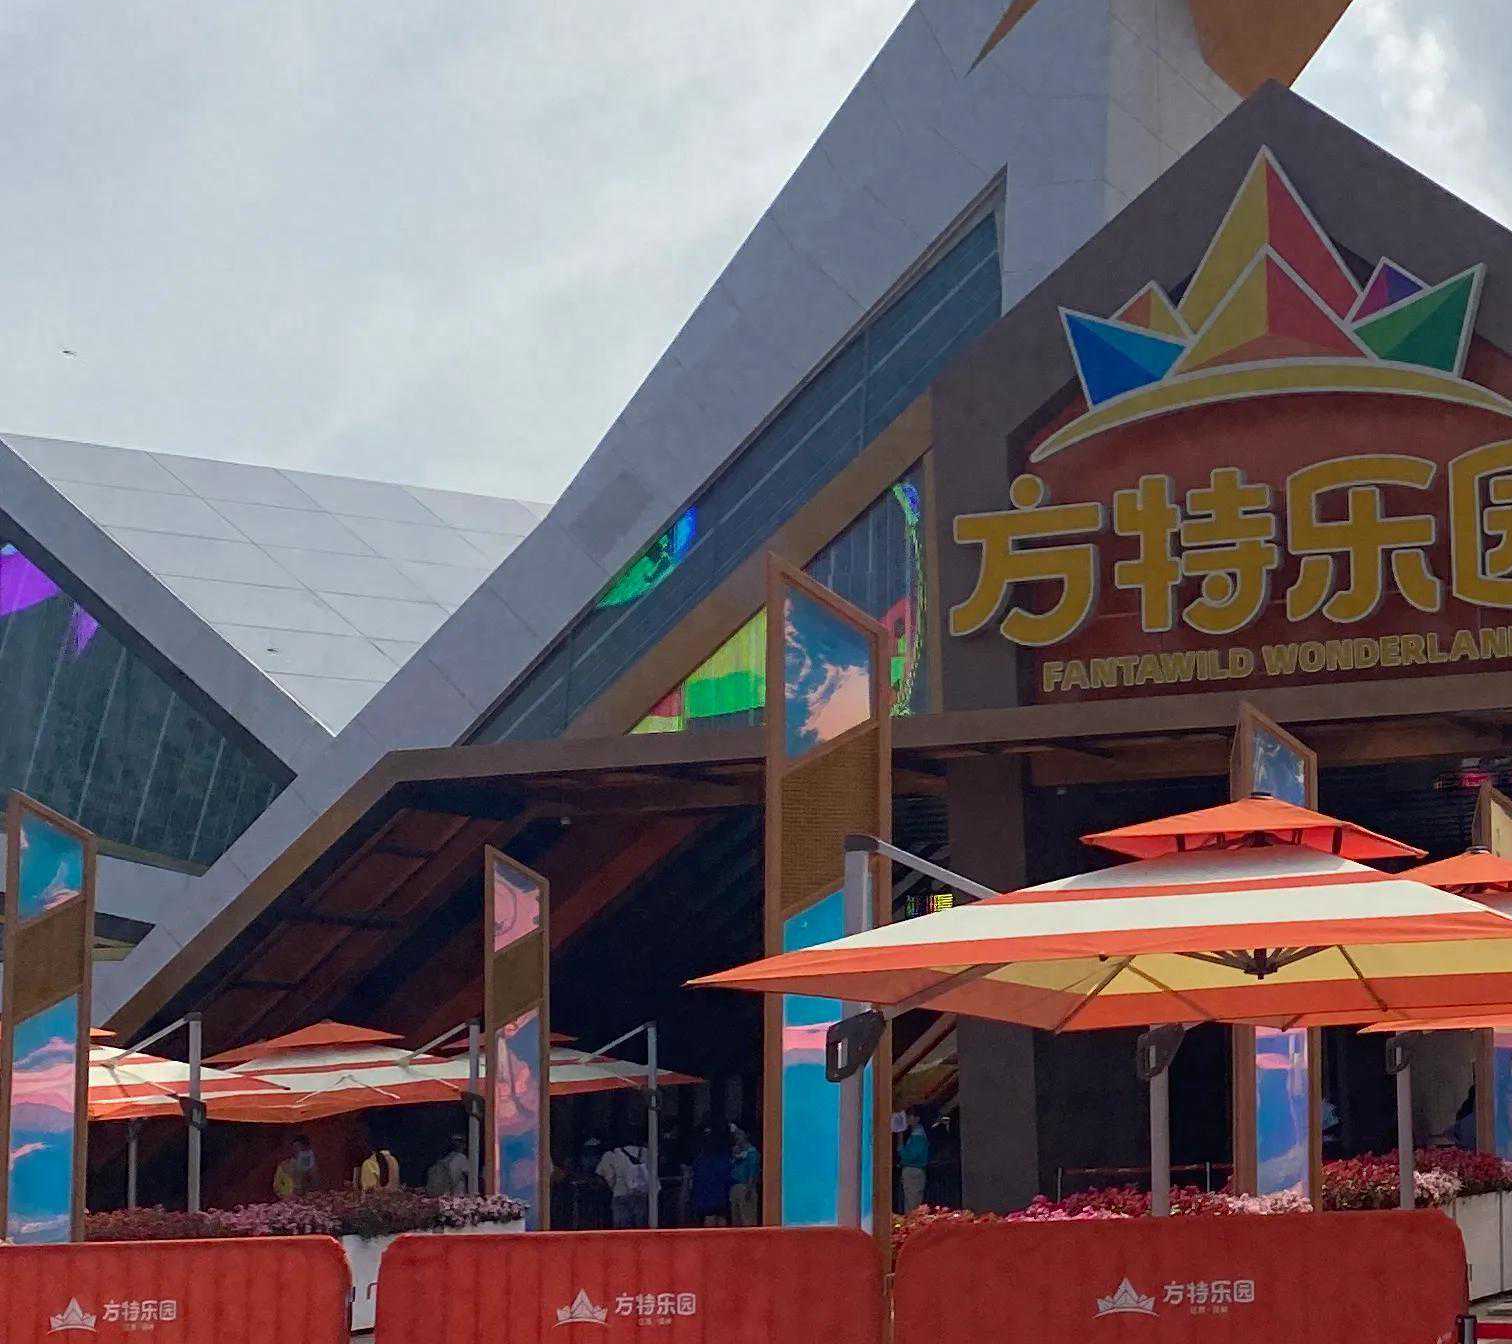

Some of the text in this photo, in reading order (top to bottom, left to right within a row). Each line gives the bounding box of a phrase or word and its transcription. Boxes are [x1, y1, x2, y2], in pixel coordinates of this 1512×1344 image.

[1042, 648, 1255, 693] FANTAWILD
[615, 1292, 696, 1316] 方特乐园
[1162, 1280, 1255, 1305] 方特乐园
[102, 1298, 177, 1322] 方特乐园
